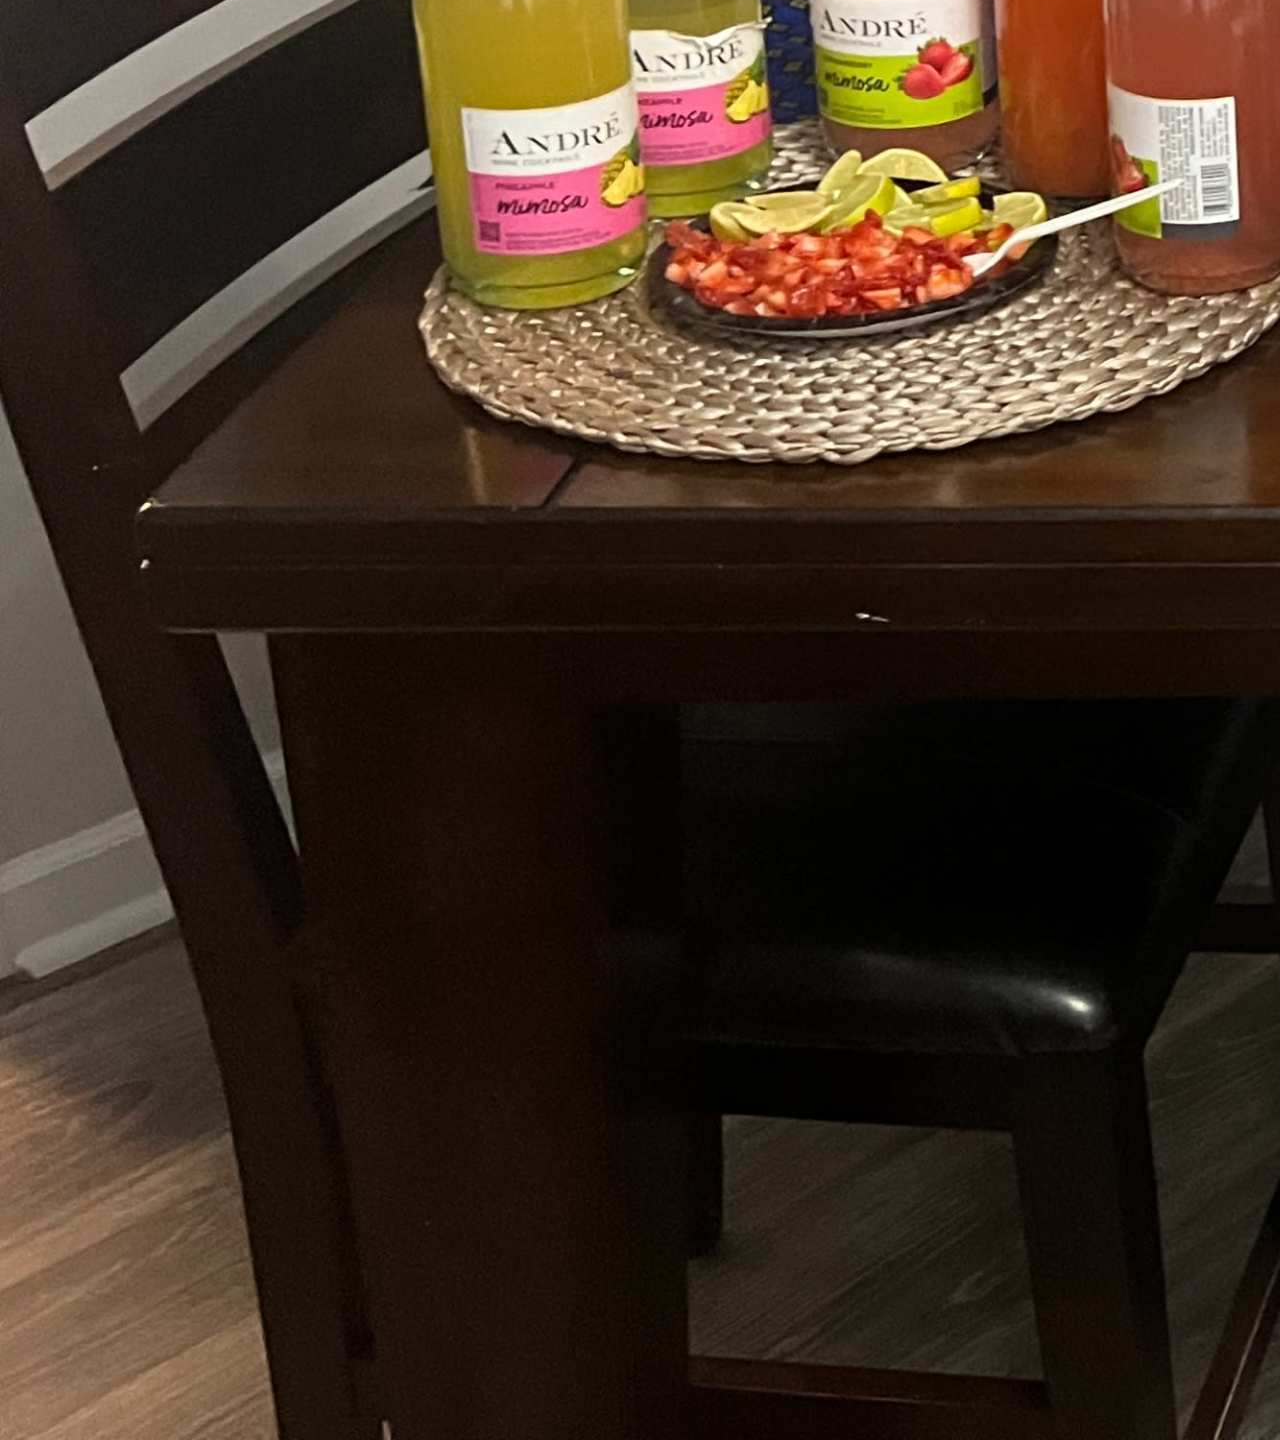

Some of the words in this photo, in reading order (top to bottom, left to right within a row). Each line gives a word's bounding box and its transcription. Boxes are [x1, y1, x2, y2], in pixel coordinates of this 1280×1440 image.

[820, 9, 928, 39] ANDRÉ
[824, 71, 890, 92] mimosa
[491, 111, 622, 156] ANDRÉ
[496, 194, 589, 216] mimosa
